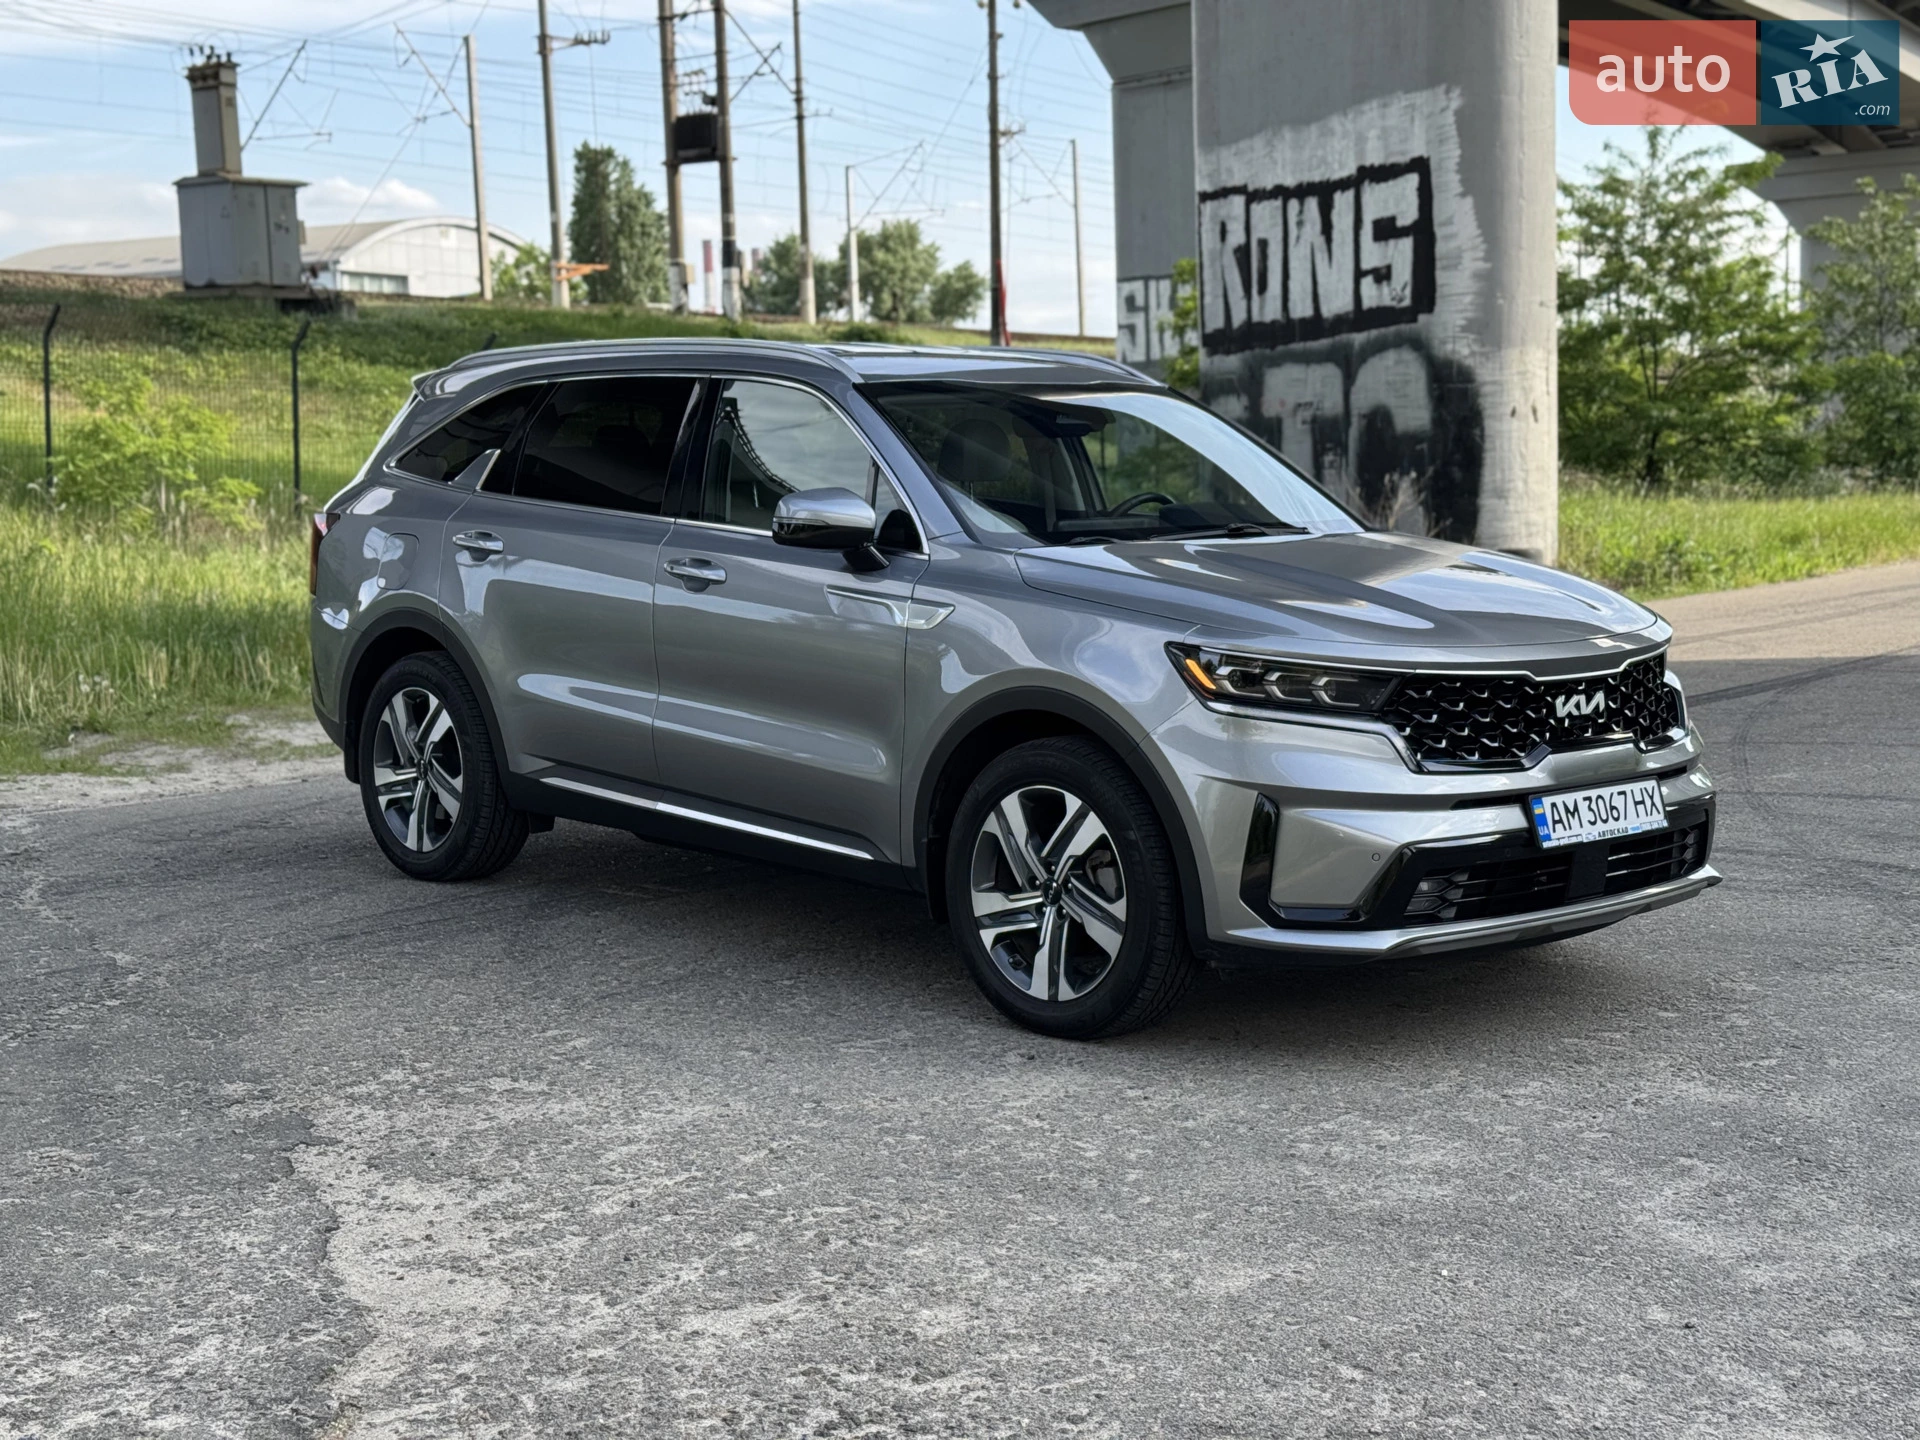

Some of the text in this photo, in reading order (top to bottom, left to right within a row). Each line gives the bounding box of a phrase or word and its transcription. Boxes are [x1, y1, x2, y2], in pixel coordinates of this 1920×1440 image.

[1550, 786, 1661, 833] AM 3067 HX
[1537, 825, 1549, 836] UA
